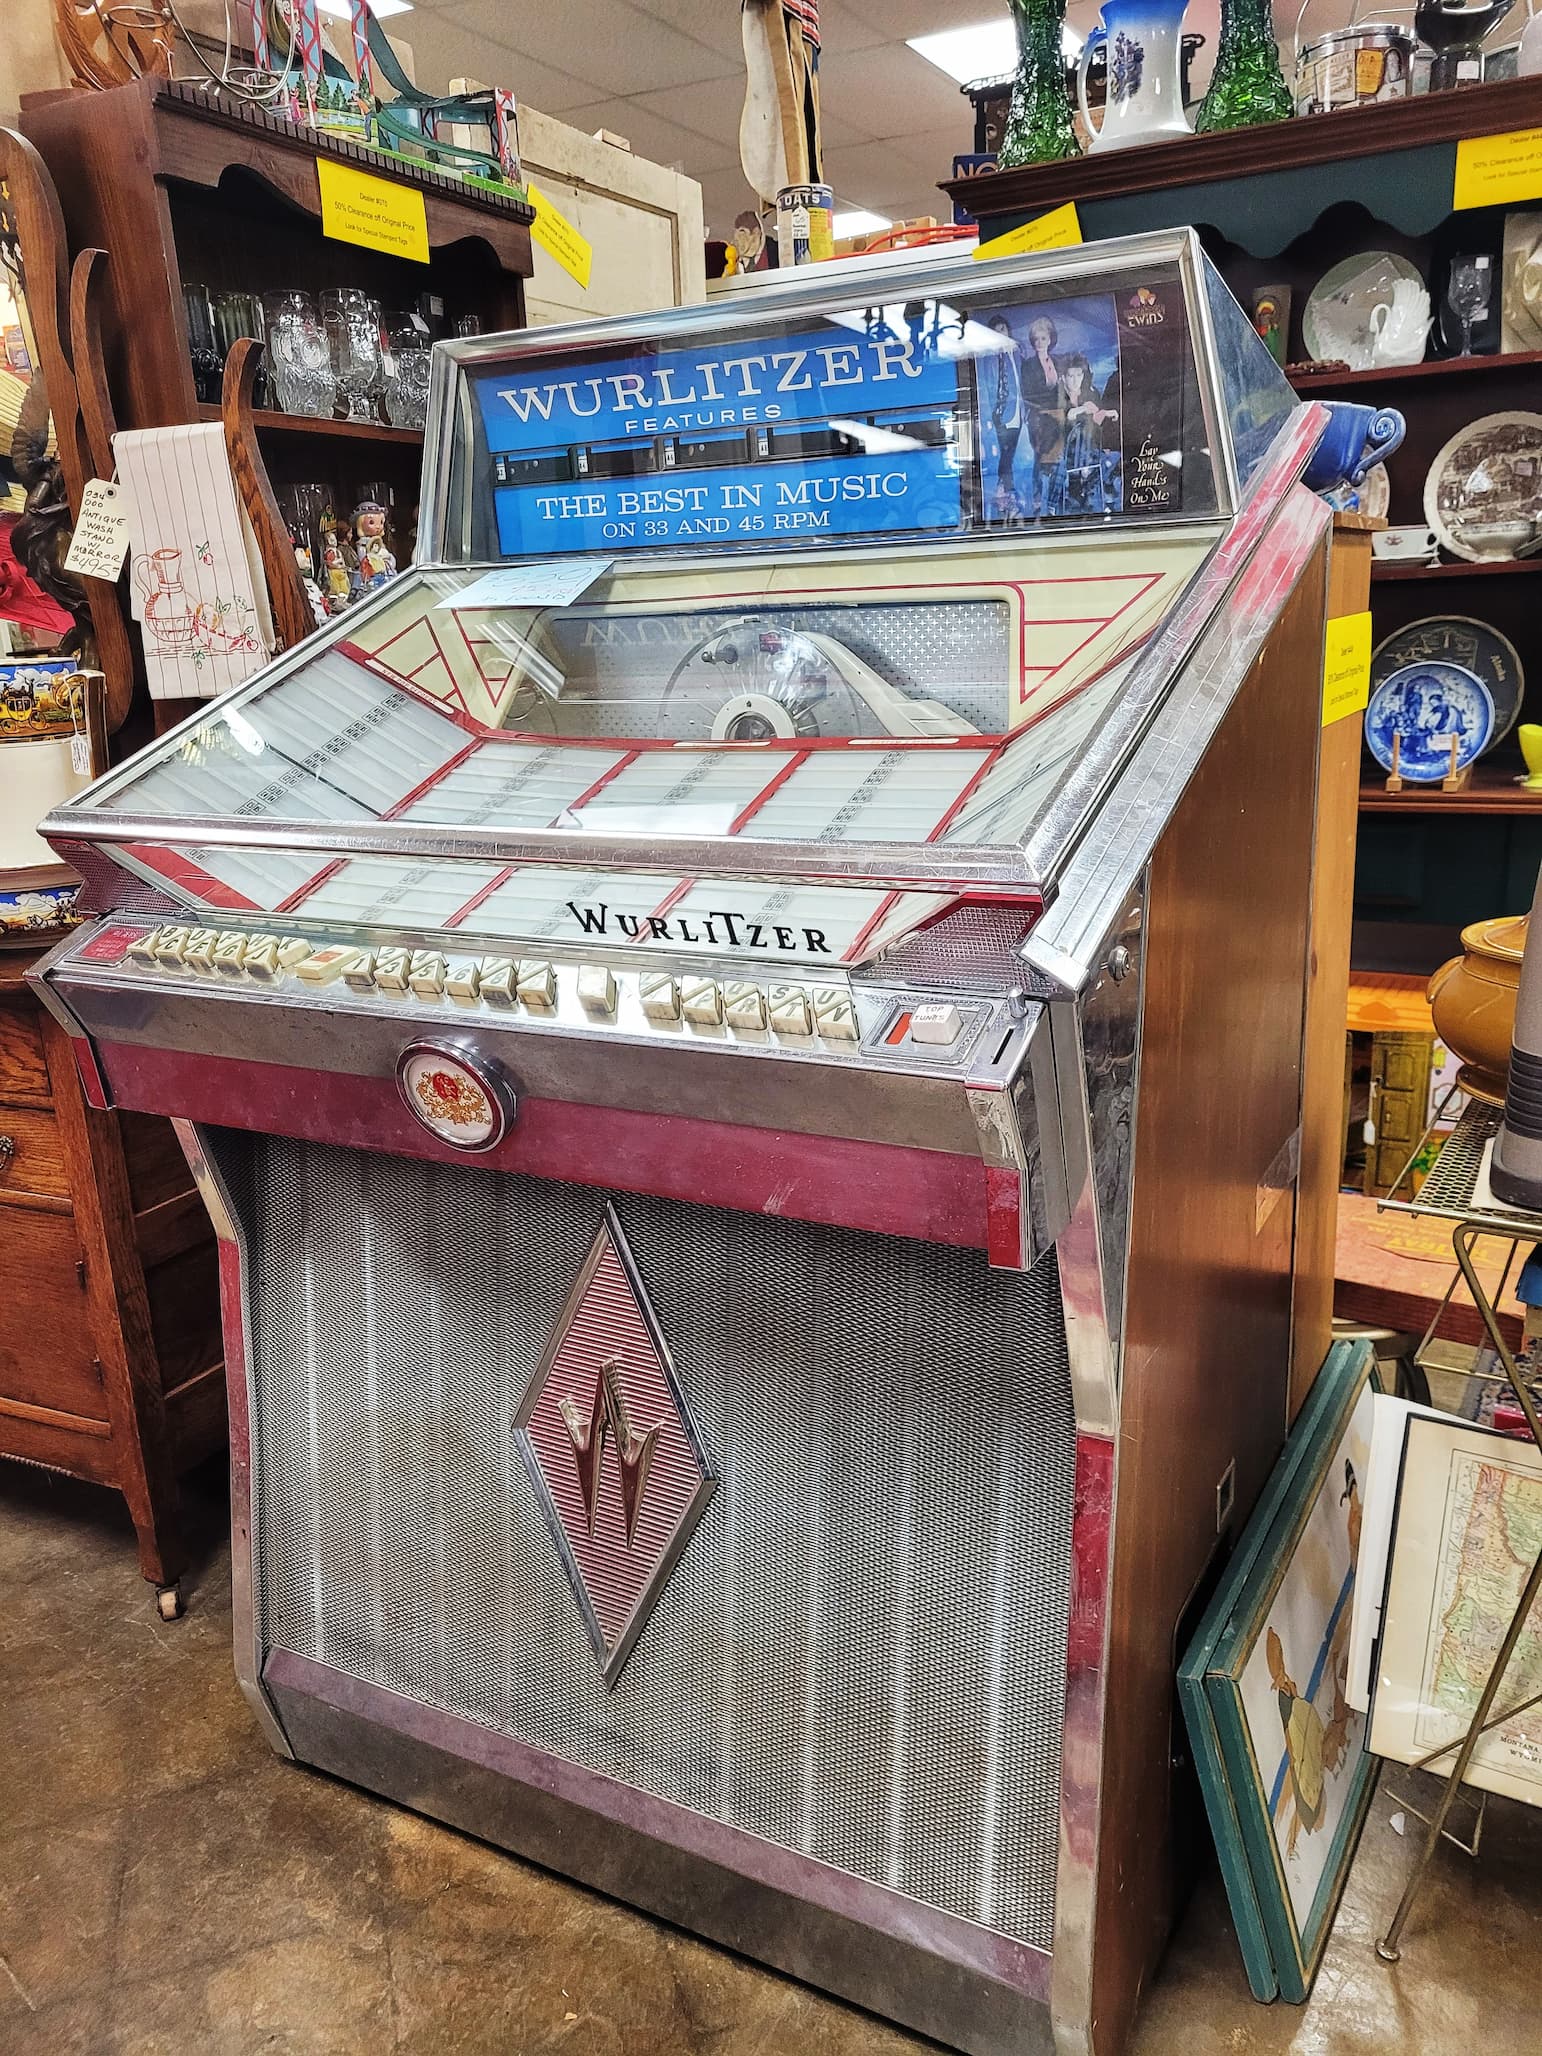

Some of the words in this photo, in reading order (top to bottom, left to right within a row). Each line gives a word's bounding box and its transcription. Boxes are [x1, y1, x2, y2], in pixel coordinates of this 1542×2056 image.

[784, 190, 820, 206] OATS
[334, 201, 347, 212] 50%
[347, 205, 373, 219] Clearance
[381, 216, 401, 228] Original
[402, 221, 415, 232] Price
[497, 340, 922, 423] WURLITZER
[625, 405, 781, 433] FEATURES
[1140, 440, 1158, 461] Lay
[1131, 457, 1164, 472] Your
[1131, 470, 1168, 488] Hands
[536, 494, 607, 519] THE
[617, 487, 708, 515] BEST
[720, 484, 764, 509] IN
[776, 472, 908, 505] MUSIC
[1130, 493, 1148, 504] On
[1145, 487, 1169, 502] Me
[82, 508, 126, 526] ANTIQUE
[602, 522, 636, 538] ON
[644, 521, 669, 536] 33
[676, 517, 730, 535] AND
[738, 515, 765, 531] 45
[773, 510, 831, 529] RPM
[87, 520, 114, 534] WASH
[80, 530, 114, 544] STAND
[566, 902, 831, 953] WURLITZER
